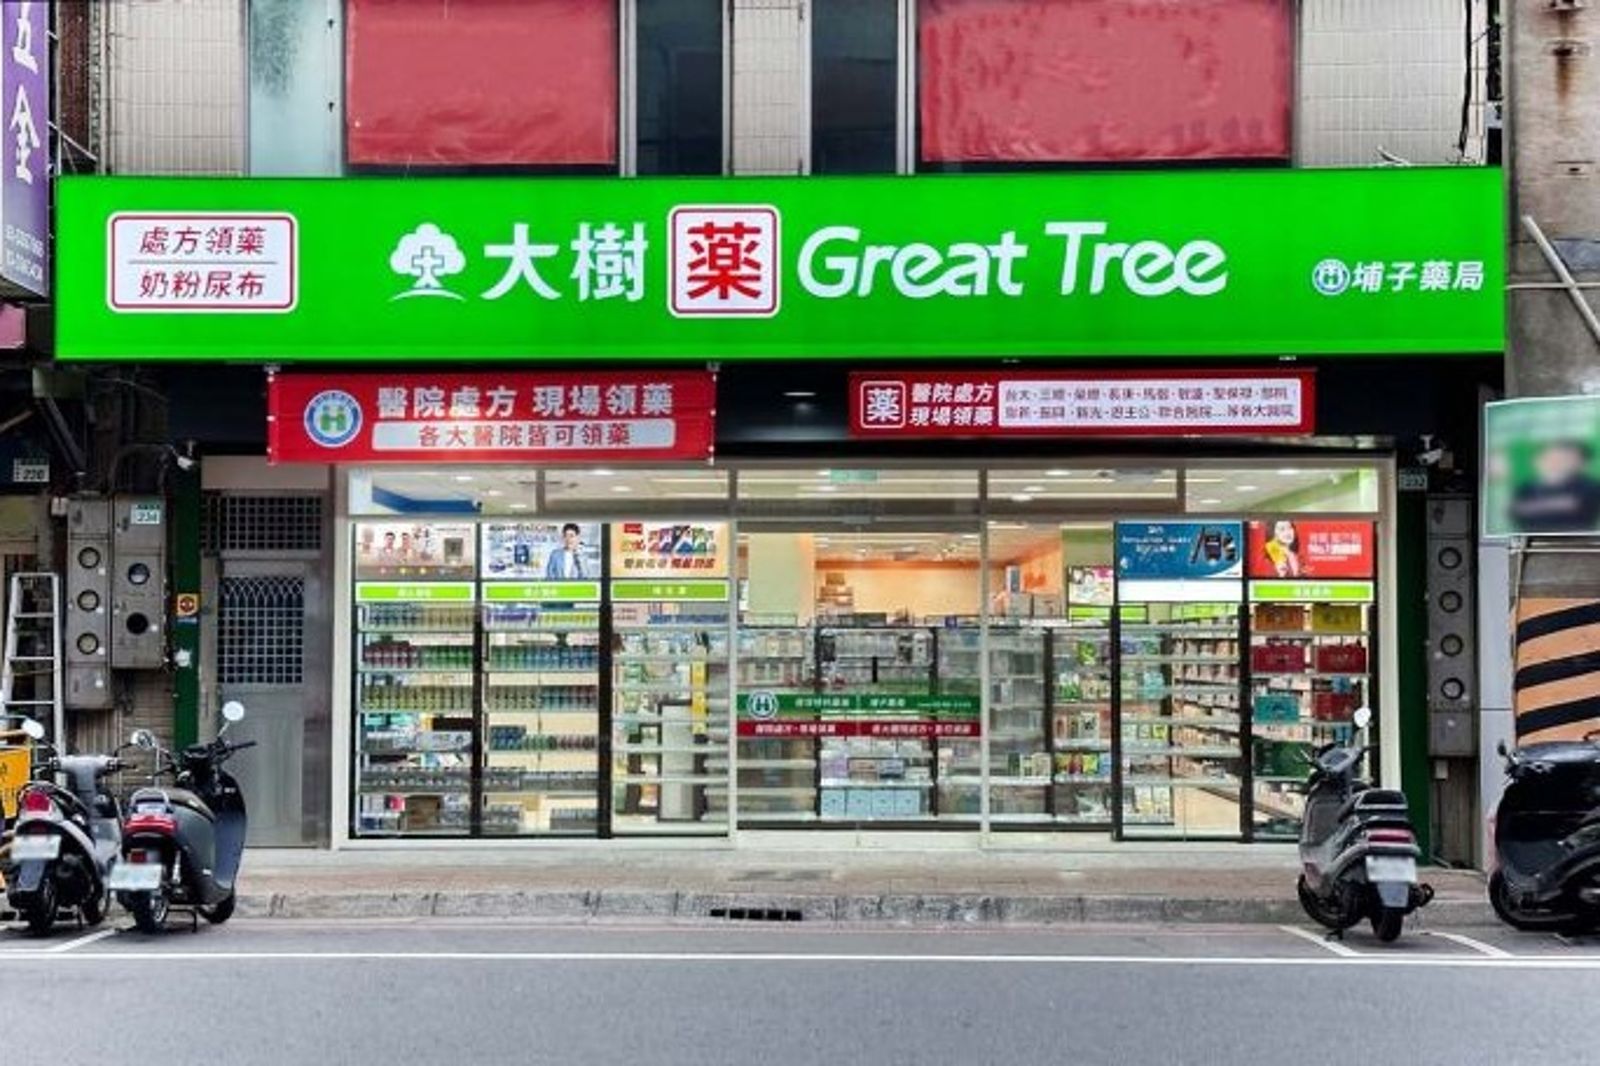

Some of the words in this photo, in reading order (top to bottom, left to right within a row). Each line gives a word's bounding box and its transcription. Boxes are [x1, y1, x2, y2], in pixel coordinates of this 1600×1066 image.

[139, 226, 267, 255] 處方領藥
[480, 222, 649, 302] 大樹
[796, 225, 1029, 299] Great
[1044, 221, 1229, 296] Tree
[139, 271, 267, 298] 奶粉尿布
[1351, 259, 1485, 293] 埔子藥局
[375, 385, 517, 420] 醫院處方
[532, 383, 675, 418] 現場領藥
[911, 382, 996, 404] 醫院處方
[909, 406, 995, 427] 現場領藥
[418, 423, 633, 448] 各大醫院皆可領藥
